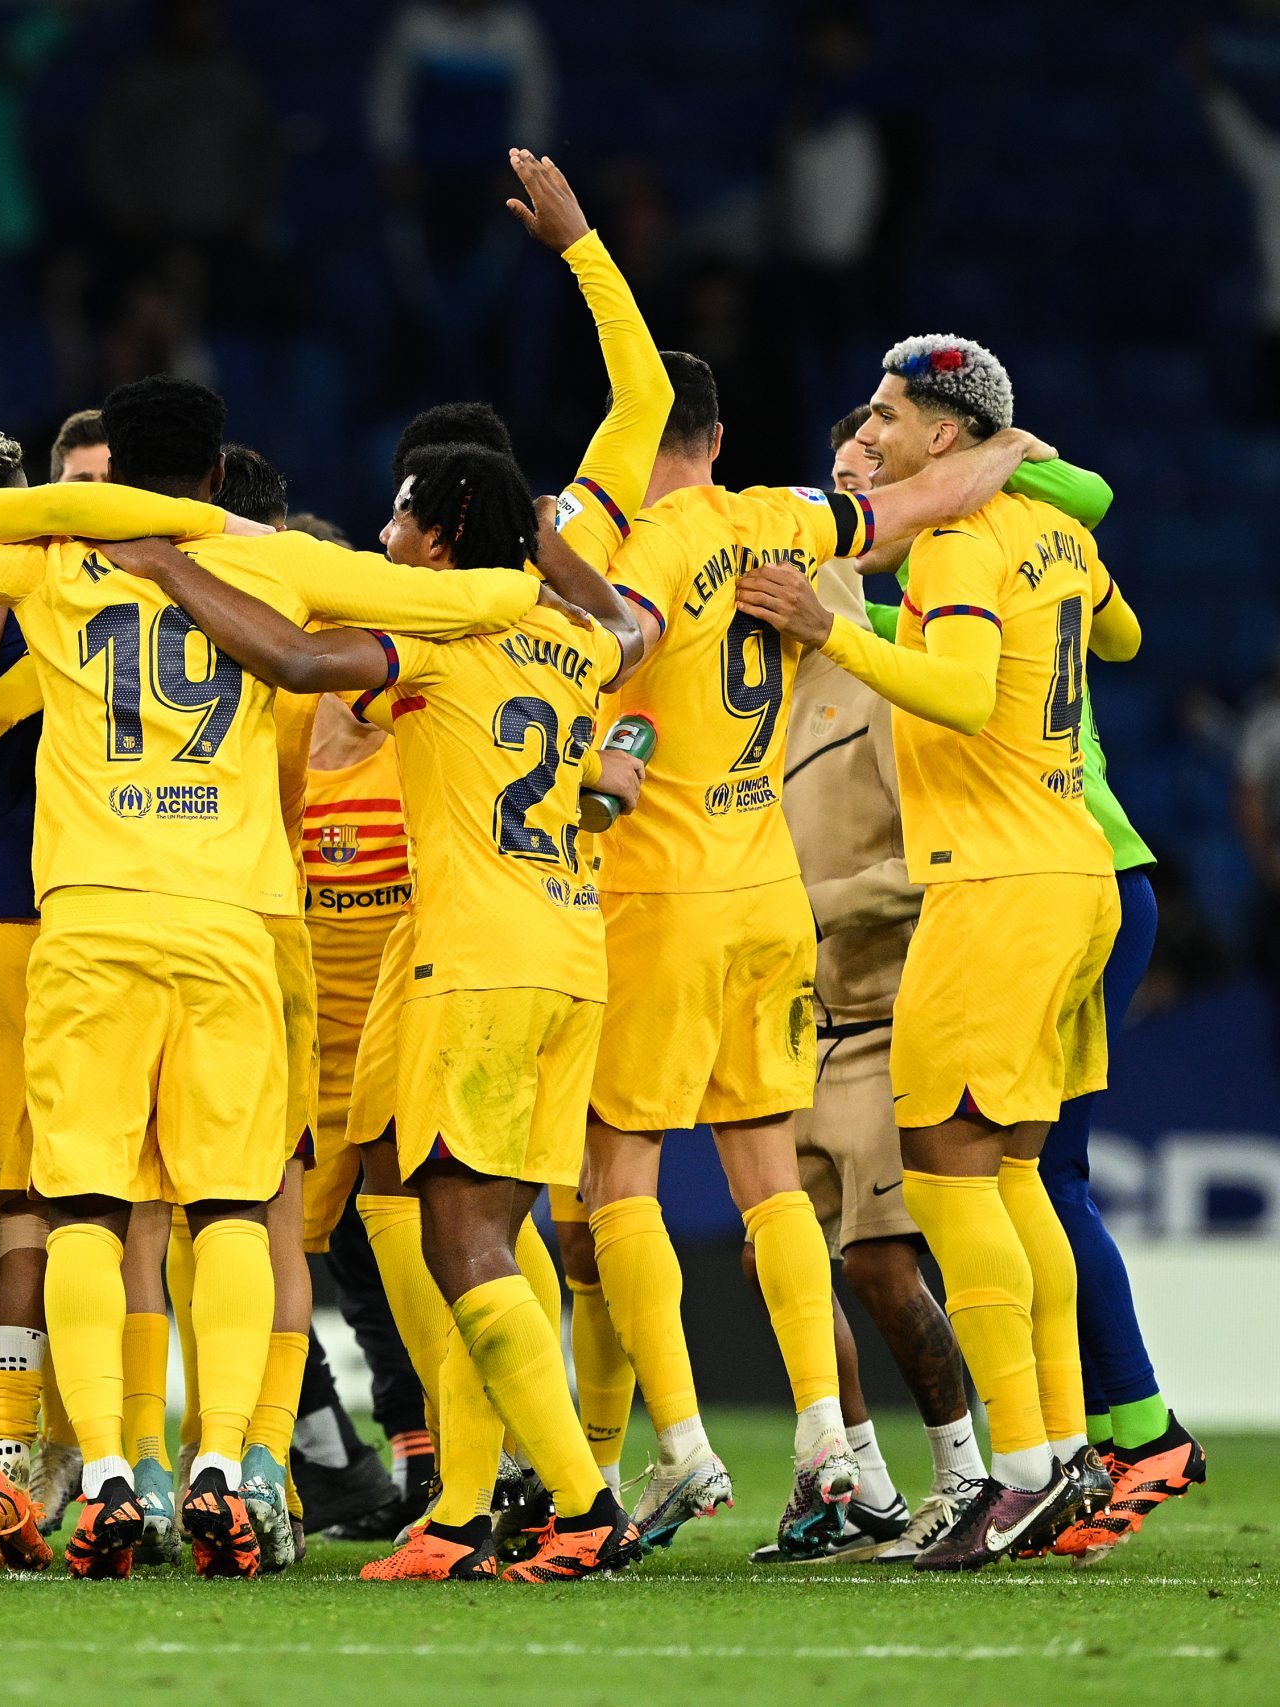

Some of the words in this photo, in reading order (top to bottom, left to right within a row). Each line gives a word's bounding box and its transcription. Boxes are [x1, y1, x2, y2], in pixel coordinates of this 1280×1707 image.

[499, 633, 593, 690] KOUNDE
[78, 603, 243, 764] 19
[720, 606, 783, 773] 9
[1043, 596, 1083, 763] 4
[156, 786, 218, 799] UNHCR
[736, 775, 770, 793] UNHCR
[156, 800, 218, 813] ACNUR
[736, 789, 776, 807] ACNUR
[319, 885, 412, 914] Spotify
[573, 892, 599, 906] ACNU
